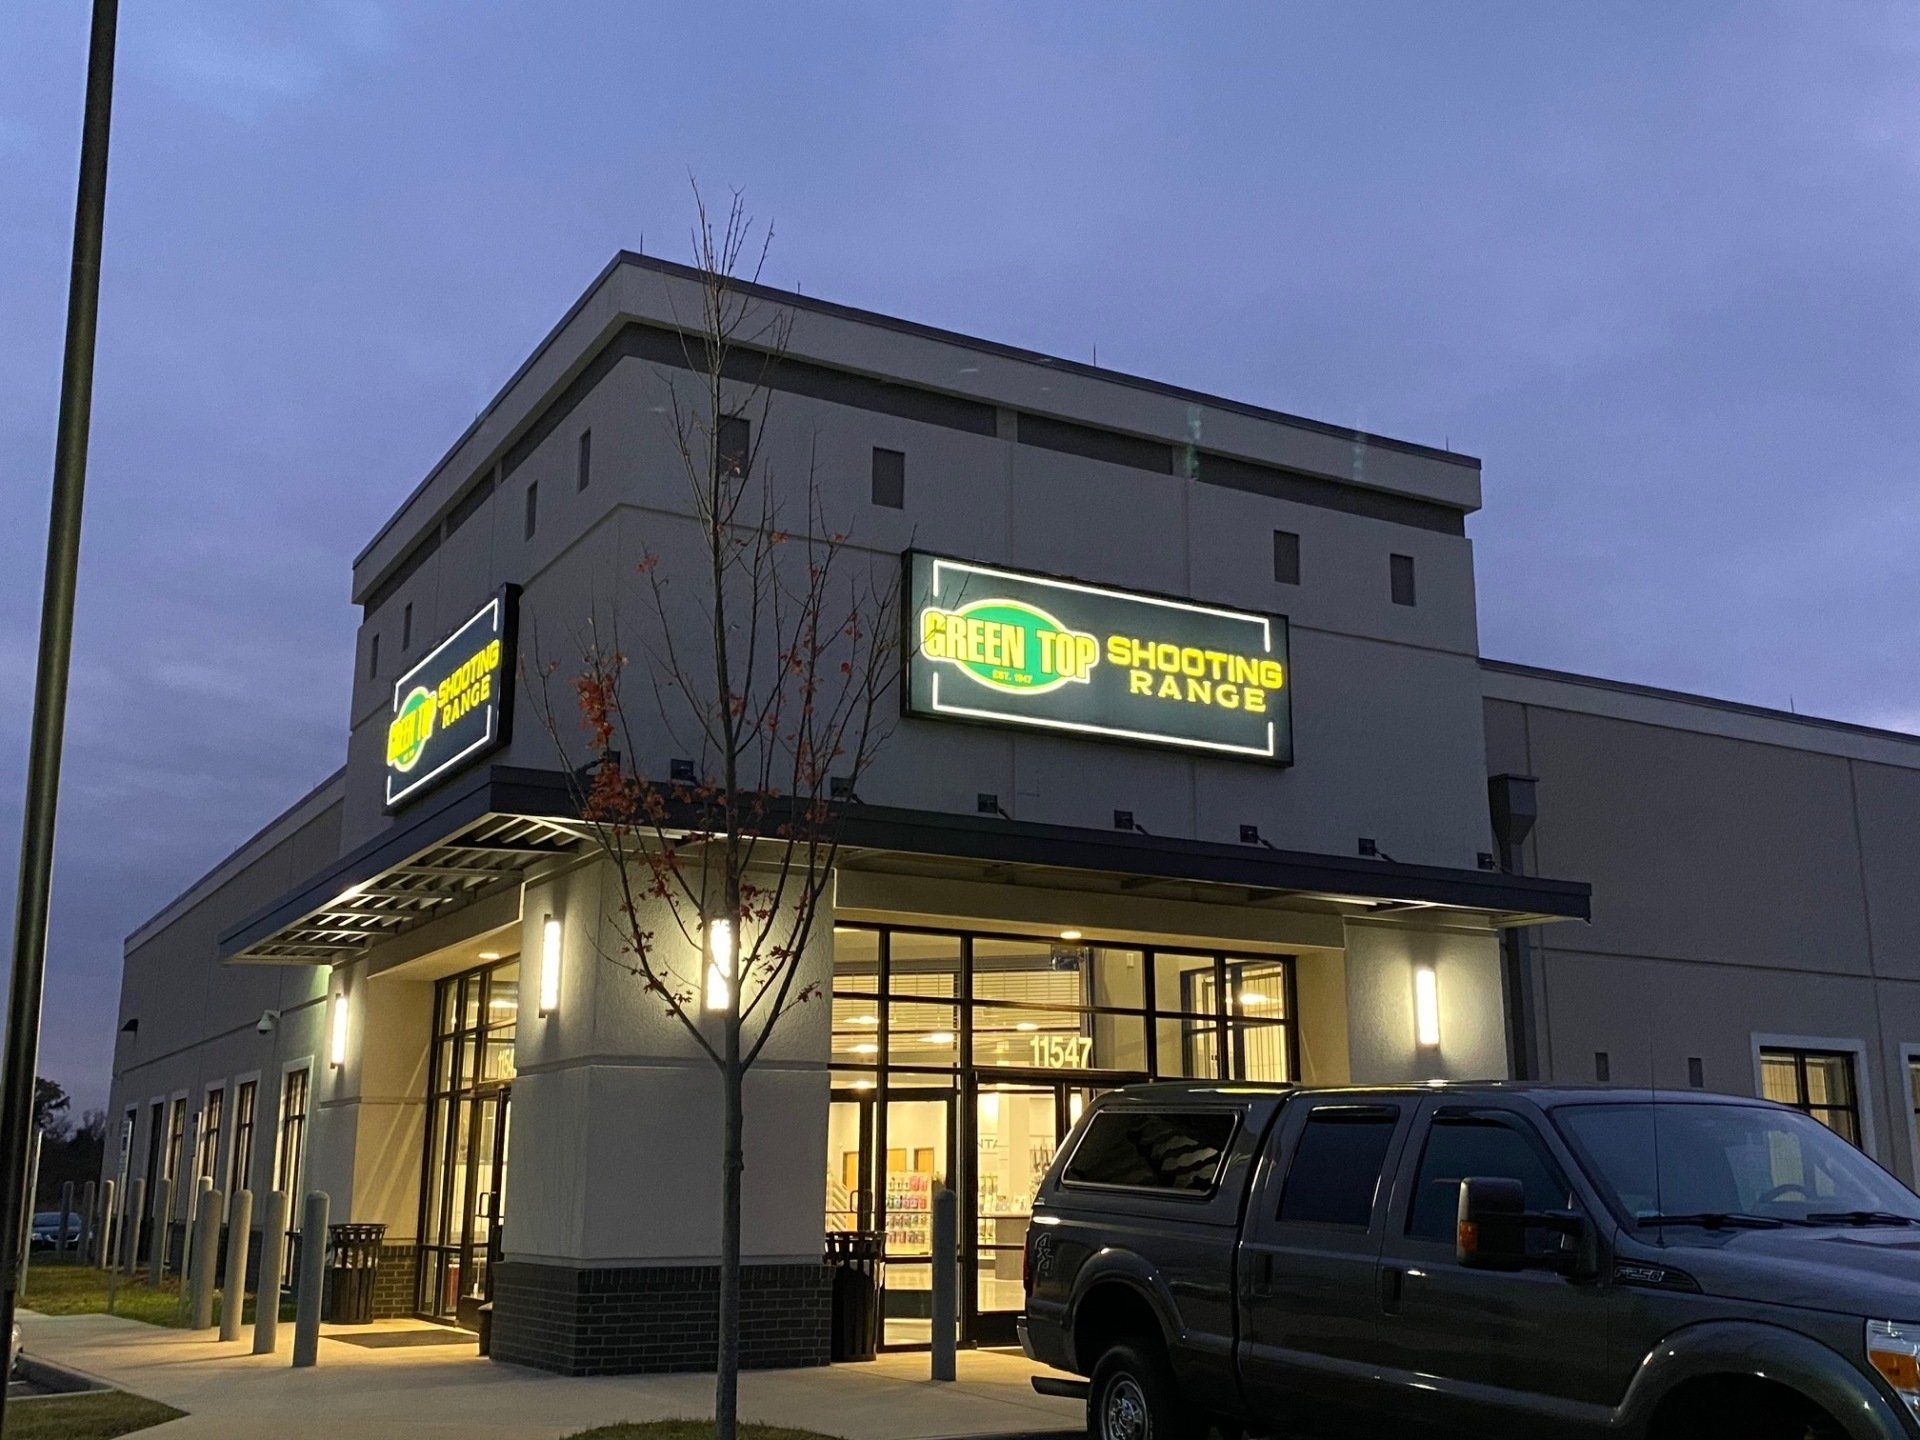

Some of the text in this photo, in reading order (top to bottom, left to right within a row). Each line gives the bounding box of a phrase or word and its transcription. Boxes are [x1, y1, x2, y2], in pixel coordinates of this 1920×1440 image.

[923, 610, 1097, 680] GREEN TOP
[1107, 634, 1284, 690] SHOOTING
[437, 638, 501, 709] SHOOTING
[441, 673, 492, 730] RANGE
[1129, 668, 1267, 713] RANGE
[1029, 1034, 1094, 1071] 11547
